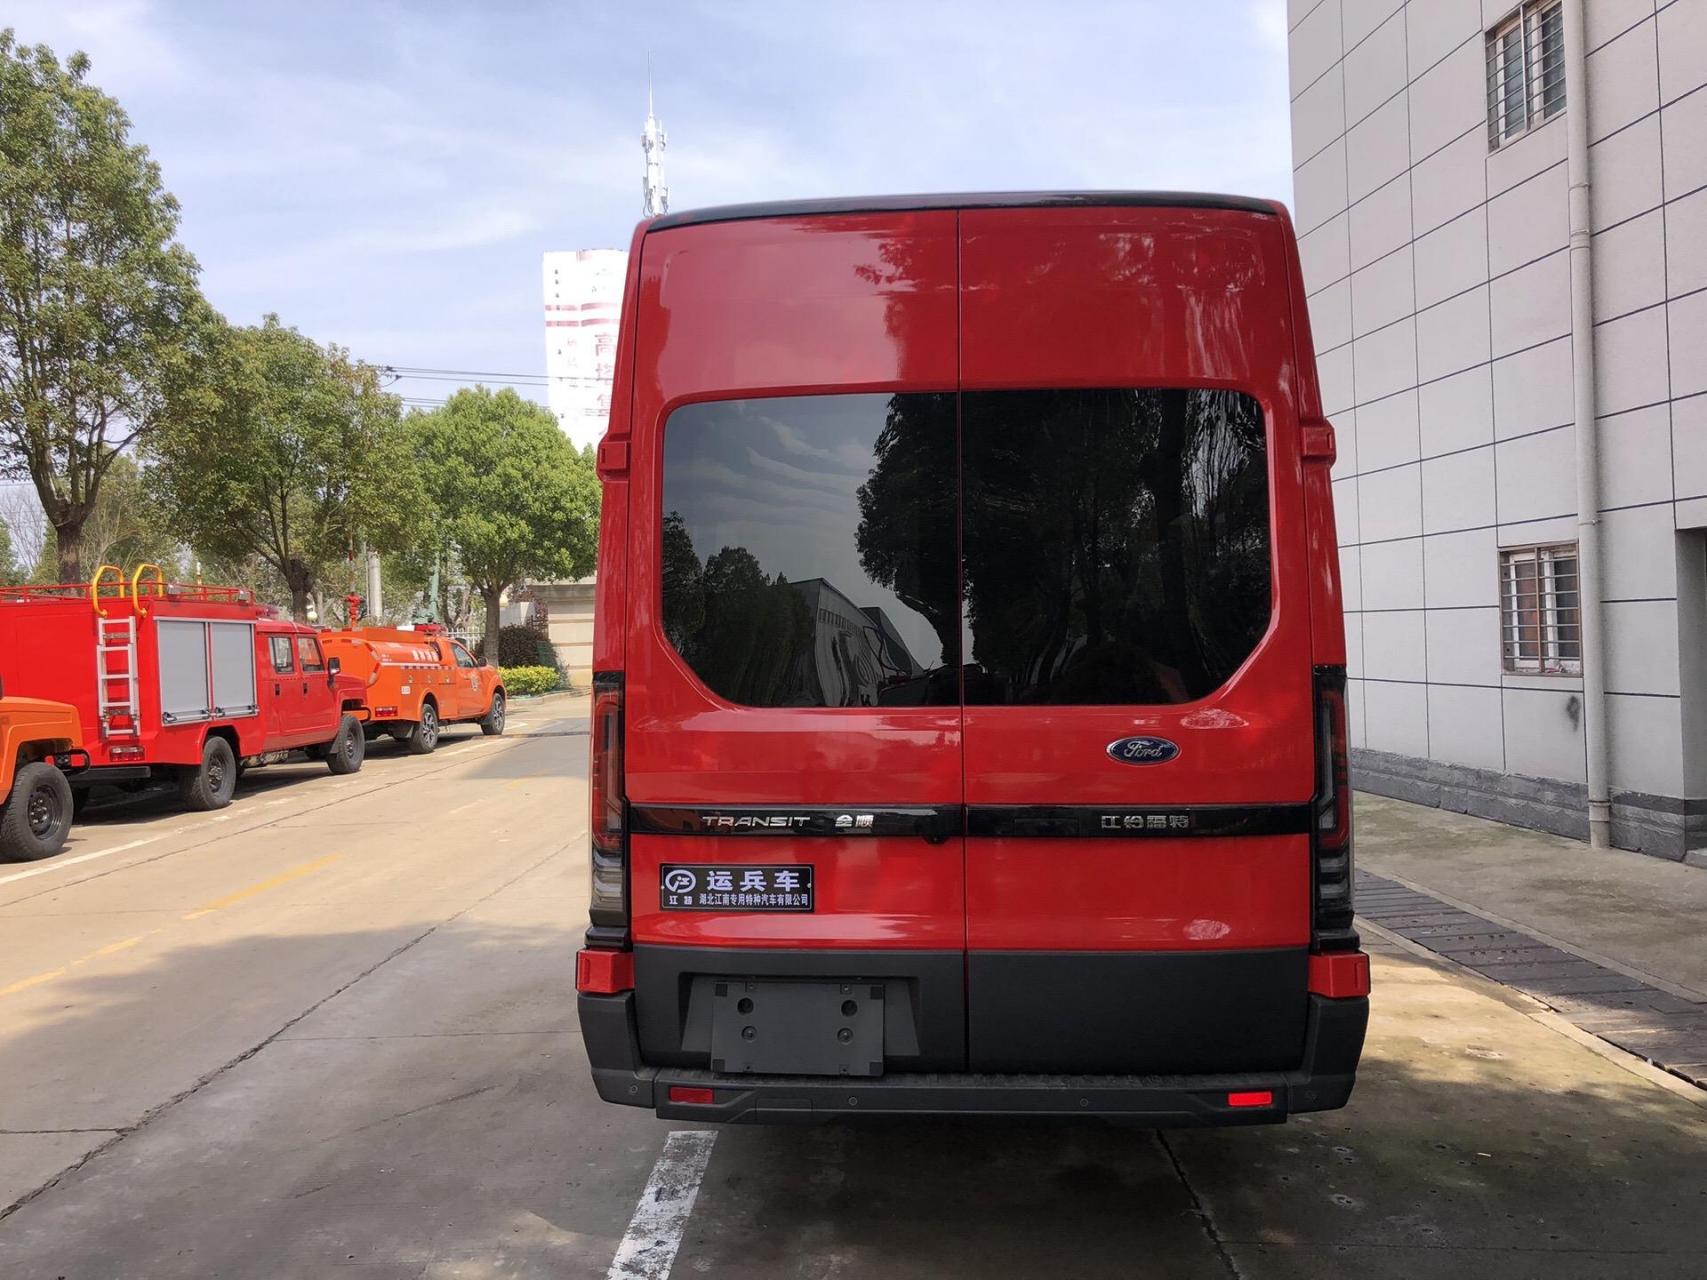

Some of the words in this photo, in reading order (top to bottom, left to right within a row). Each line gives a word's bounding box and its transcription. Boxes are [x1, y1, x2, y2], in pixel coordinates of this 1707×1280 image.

[1123, 740, 1165, 758] Ford
[702, 816, 811, 827] TRANSIT
[835, 814, 874, 828] 全顺
[706, 870, 801, 892] 运兵车
[699, 893, 808, 906] 湖北江南专用特种汽车有限公司
